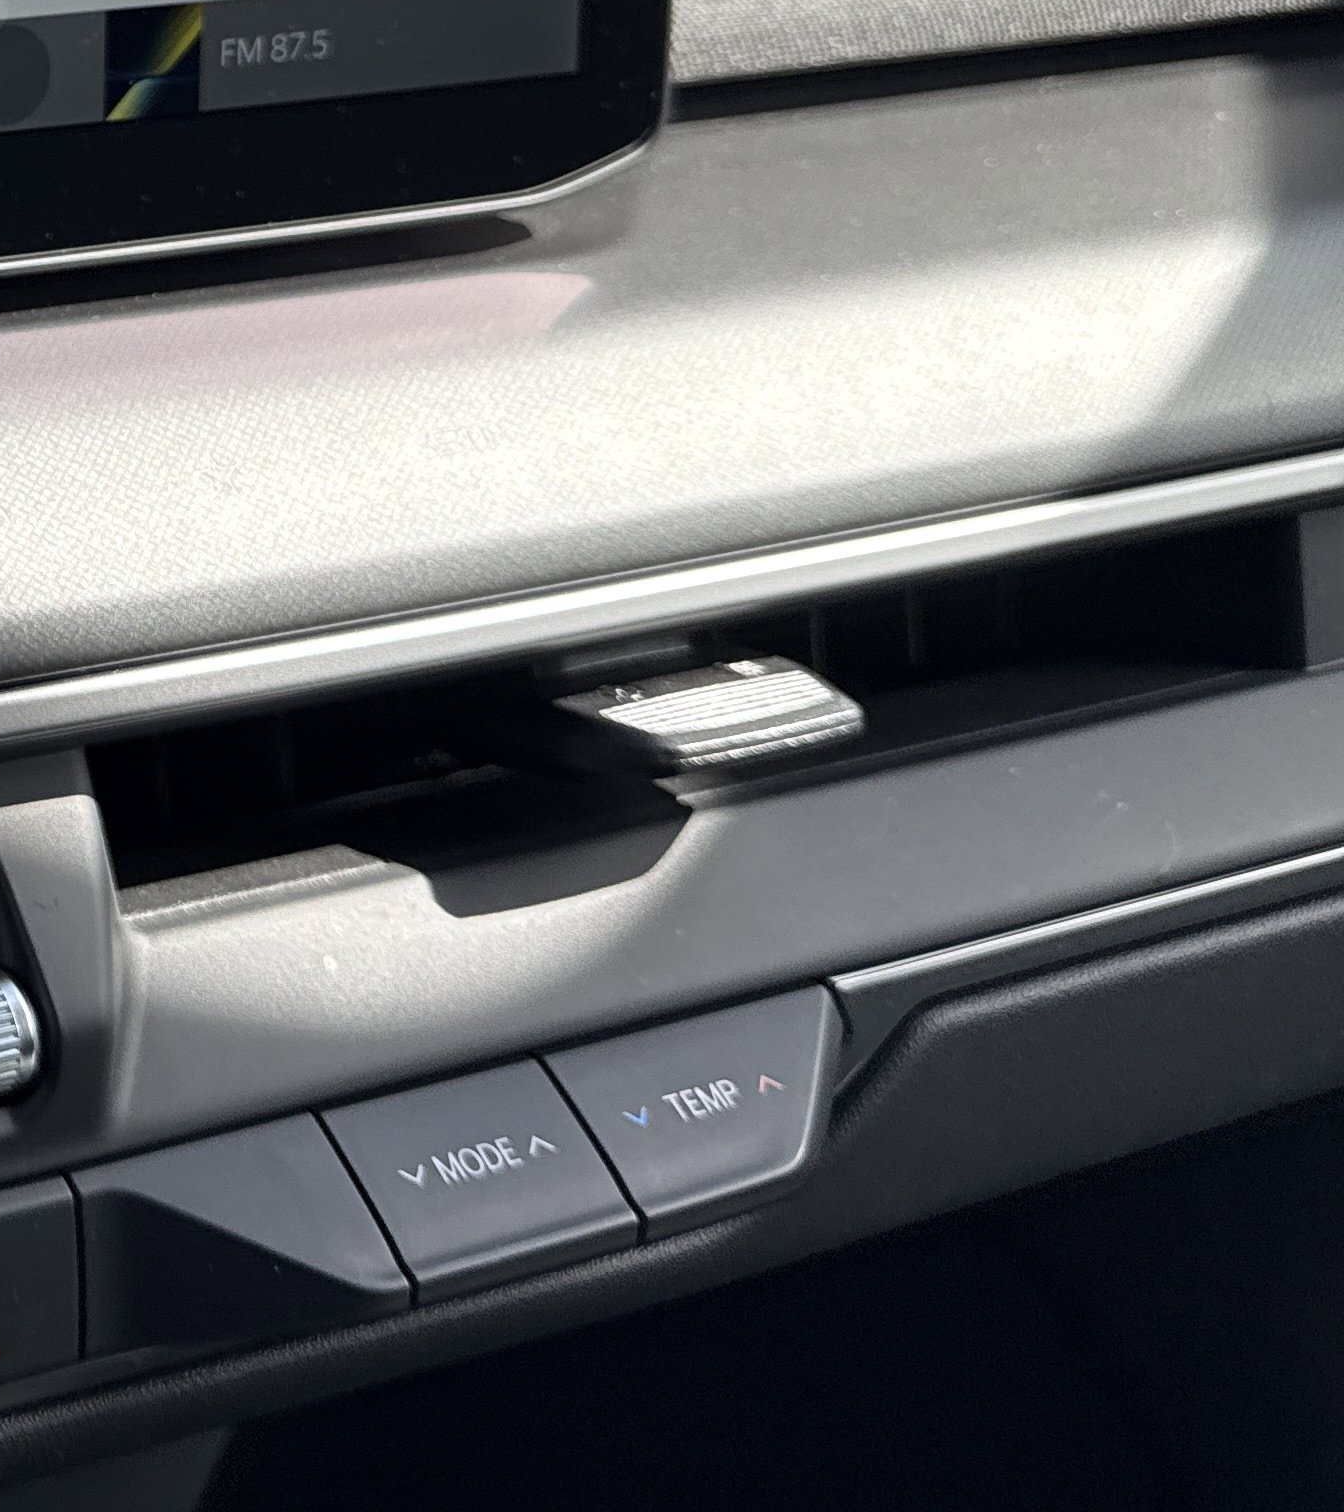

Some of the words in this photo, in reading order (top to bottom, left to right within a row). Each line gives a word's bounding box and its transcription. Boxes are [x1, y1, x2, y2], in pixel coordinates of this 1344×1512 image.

[221, 36, 262, 67] FM
[270, 29, 330, 63] 87.5
[662, 1079, 738, 1122] TEMP
[431, 1136, 523, 1185] MODE
